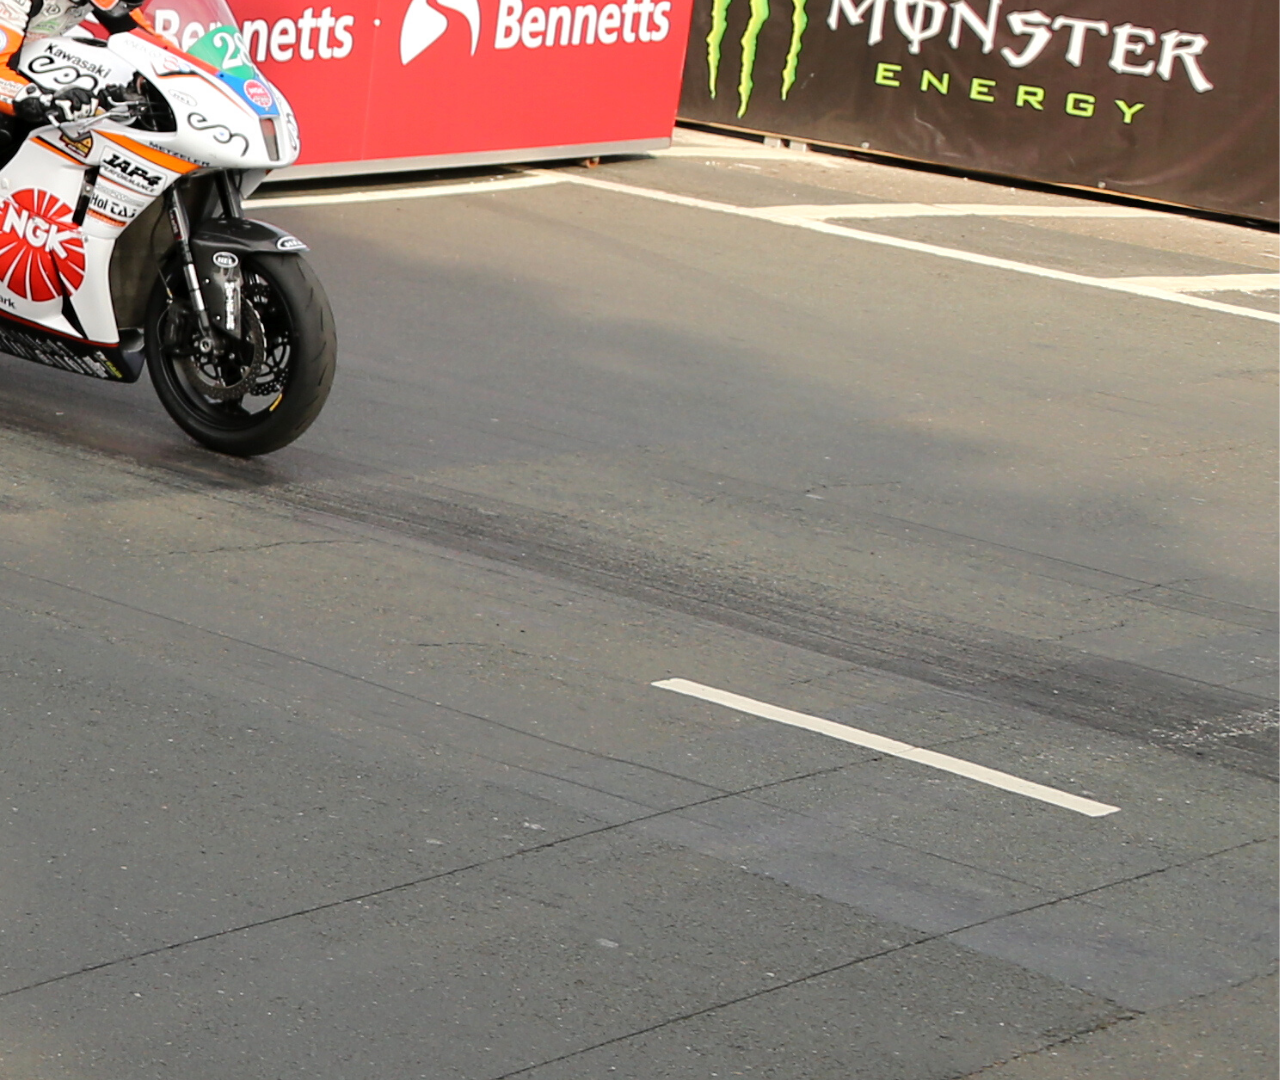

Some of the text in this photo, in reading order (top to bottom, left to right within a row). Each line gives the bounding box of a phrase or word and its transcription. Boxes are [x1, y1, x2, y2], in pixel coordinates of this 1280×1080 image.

[43, 42, 112, 79] Kawasaki
[874, 62, 1146, 125] ENERGY
[148, 140, 211, 167] METZELER
[100, 165, 157, 193] PERFORMANCE
[2, 204, 78, 259] NGK
